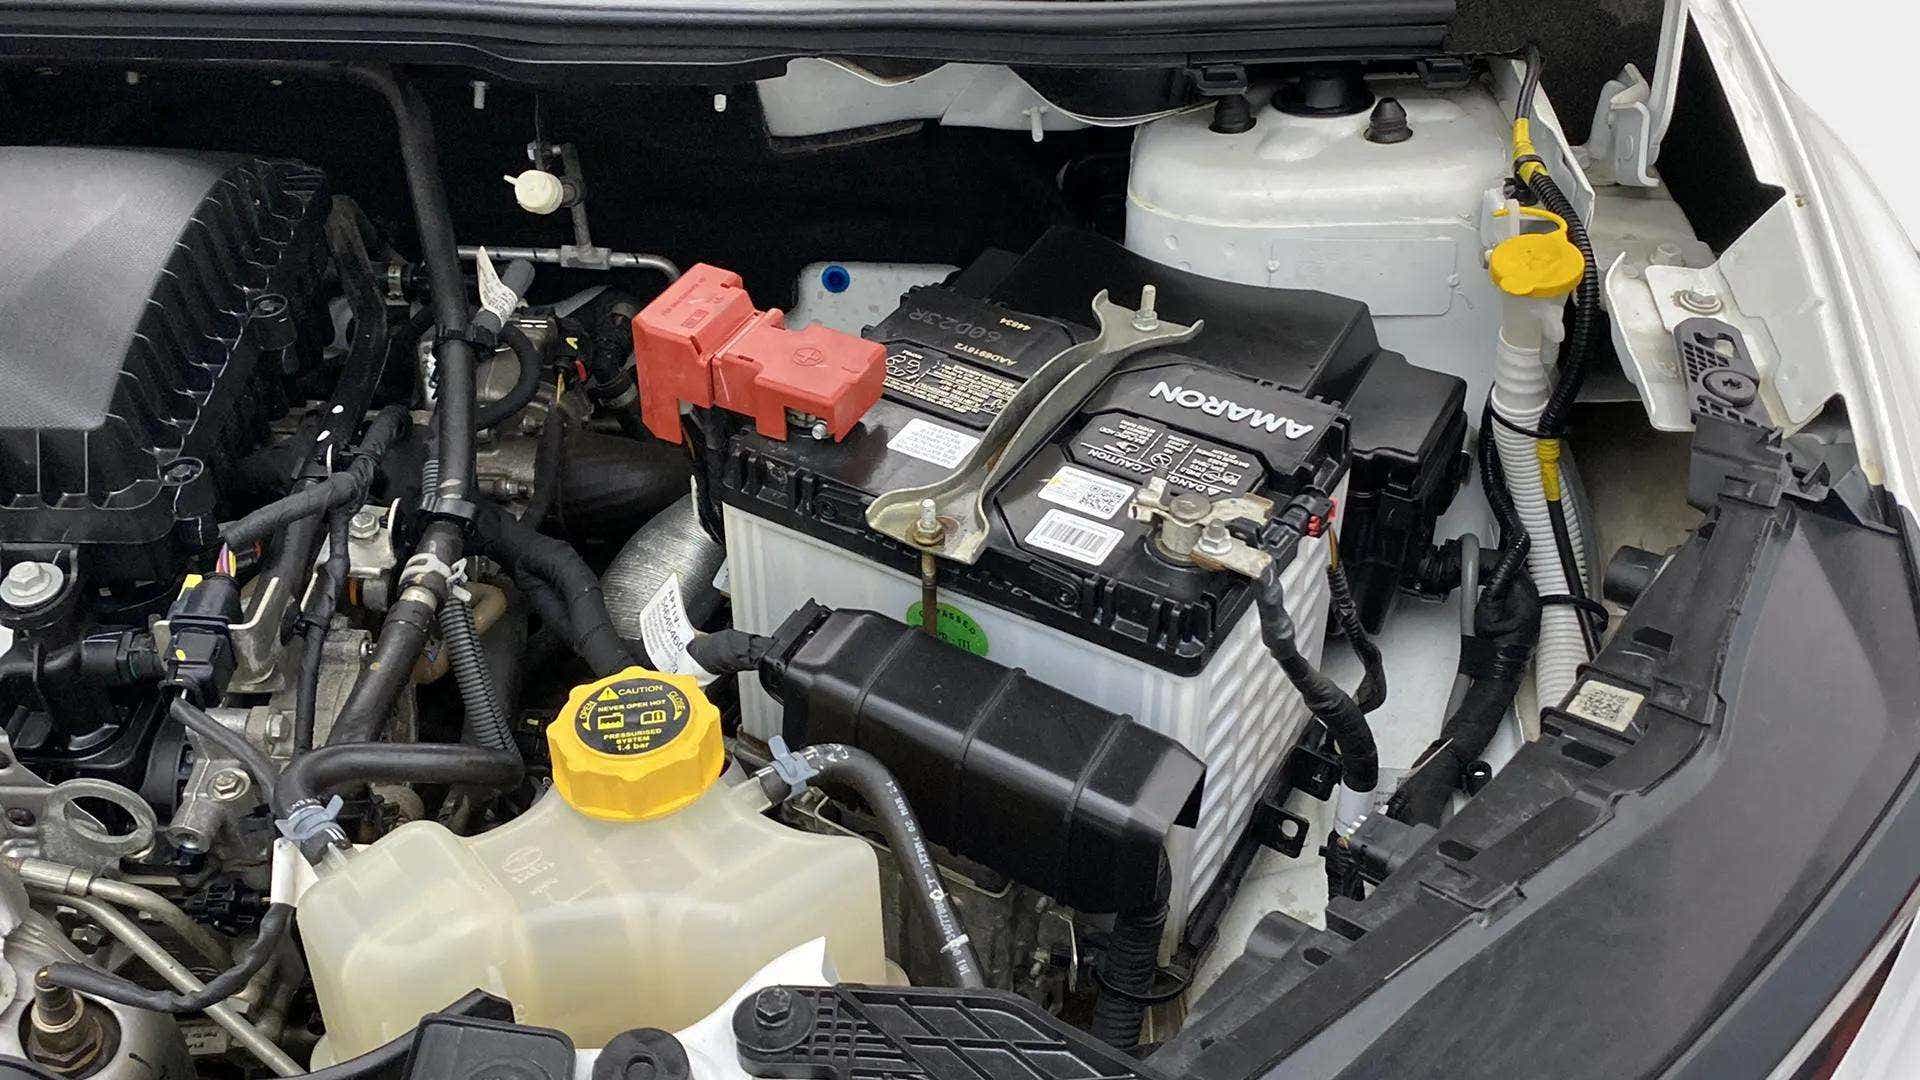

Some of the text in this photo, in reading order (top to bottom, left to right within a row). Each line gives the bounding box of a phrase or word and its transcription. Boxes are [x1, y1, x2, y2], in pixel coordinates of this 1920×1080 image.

[1150, 381, 1314, 439] AMARON
[1086, 449, 1142, 471] CAUTION
[1166, 474, 1207, 492] DANG
[618, 685, 663, 696] CAUTION
[598, 704, 625, 712] NEVER
[626, 701, 648, 709] OPEN
[603, 728, 662, 740] PRESSURISED
[616, 735, 650, 745] SYSTEM
[617, 743, 631, 751] 1.4
